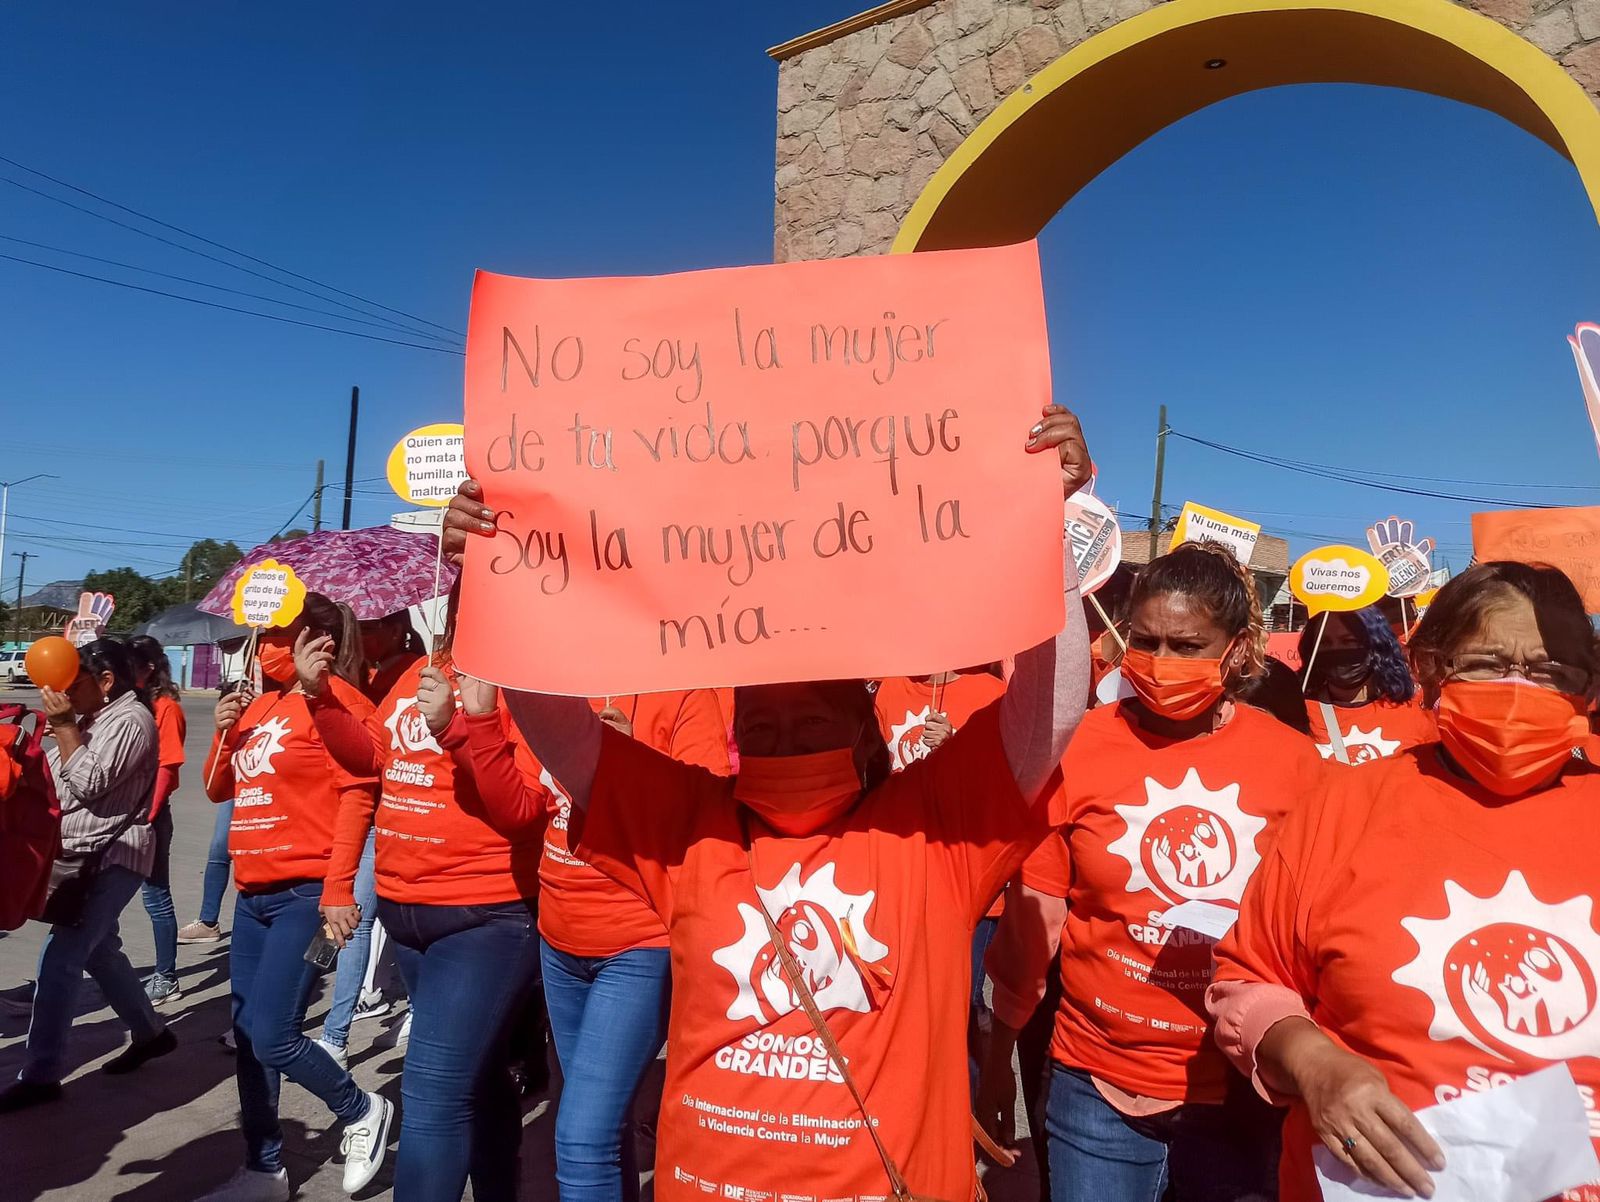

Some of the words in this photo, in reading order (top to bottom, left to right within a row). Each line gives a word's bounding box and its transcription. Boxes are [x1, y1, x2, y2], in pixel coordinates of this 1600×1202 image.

[621, 337, 703, 404] soy
[734, 307, 784, 370] la
[811, 311, 951, 385] mujer
[406, 437, 442, 448] Quien
[445, 437, 464, 446] am
[407, 456, 422, 465] no
[425, 453, 456, 463] mata
[486, 412, 545, 473] de
[792, 407, 961, 496] porque
[409, 469, 453, 481] humilla
[1191, 513, 1204, 525] Ni
[1206, 521, 1228, 534] una
[1231, 528, 1257, 543] más
[490, 510, 569, 595] Soy
[590, 509, 632, 571] la
[662, 513, 797, 586] mujer
[813, 502, 873, 559] de
[917, 484, 970, 543] la
[1378, 541, 1411, 566] LERTA
[252, 571, 277, 580] Somos
[278, 573, 286, 581] el
[1311, 567, 1338, 577] Vivas
[1340, 569, 1360, 579] nos
[274, 586, 287, 595] las
[1306, 581, 1361, 593] Queremos
[244, 599, 258, 608] que
[258, 600, 269, 609] ya
[392, 759, 425, 774] SOMOS
[385, 768, 435, 788] GRANDES
[1107, 949, 1120, 960] Día
[1121, 955, 1177, 978] Internacional
[1124, 968, 1131, 977] la
[1152, 1018, 1169, 1031] DIF
[741, 1031, 827, 1058] SOMOS
[715, 1046, 849, 1084] GRANDES
[682, 1094, 694, 1107] Día
[695, 1098, 760, 1121] Internacional
[761, 1111, 776, 1124] de
[779, 1112, 788, 1125] la
[792, 1114, 861, 1129] Eliminación
[698, 1114, 706, 1127] la
[707, 1117, 754, 1138] Violencia
[757, 1127, 798, 1143] Contra
[801, 1131, 811, 1144] la
[814, 1133, 851, 1148] Mujer
[724, 1183, 745, 1200] DIF
